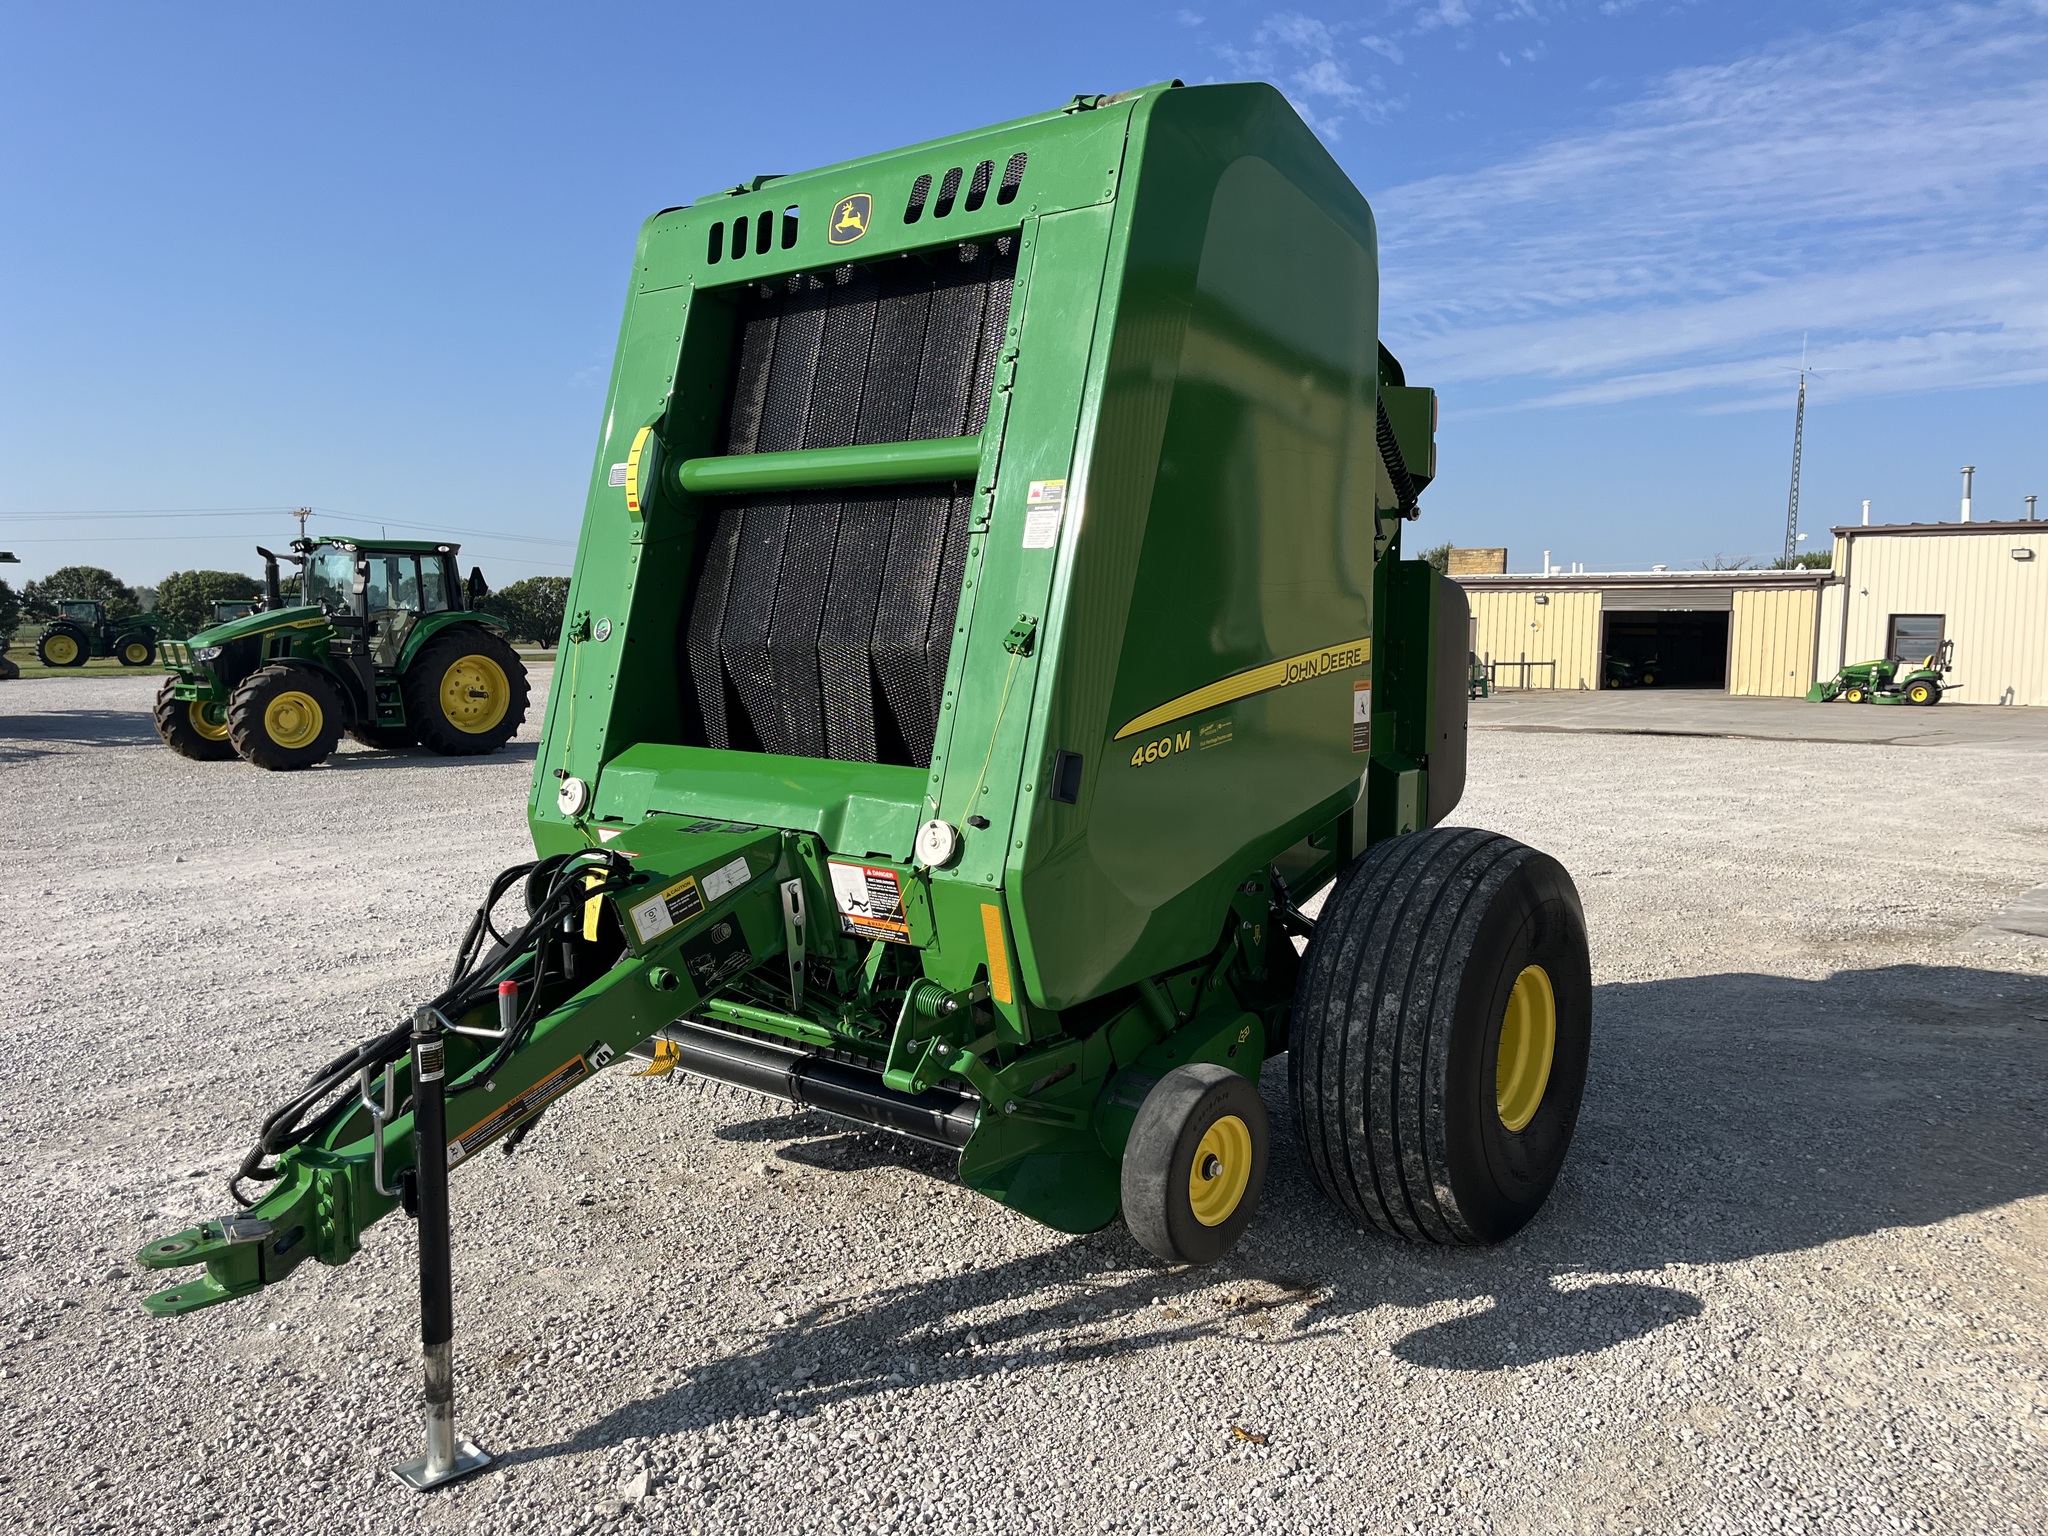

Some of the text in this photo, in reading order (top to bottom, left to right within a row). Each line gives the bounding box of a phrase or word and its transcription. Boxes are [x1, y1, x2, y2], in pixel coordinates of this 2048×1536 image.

[1280, 647, 1363, 685] JOHN DEERE
[1130, 730, 1192, 768] 460 M
[871, 870, 894, 879] DANGER
[670, 881, 691, 895] CAUTION
[511, 1087, 535, 1105] WARNING
